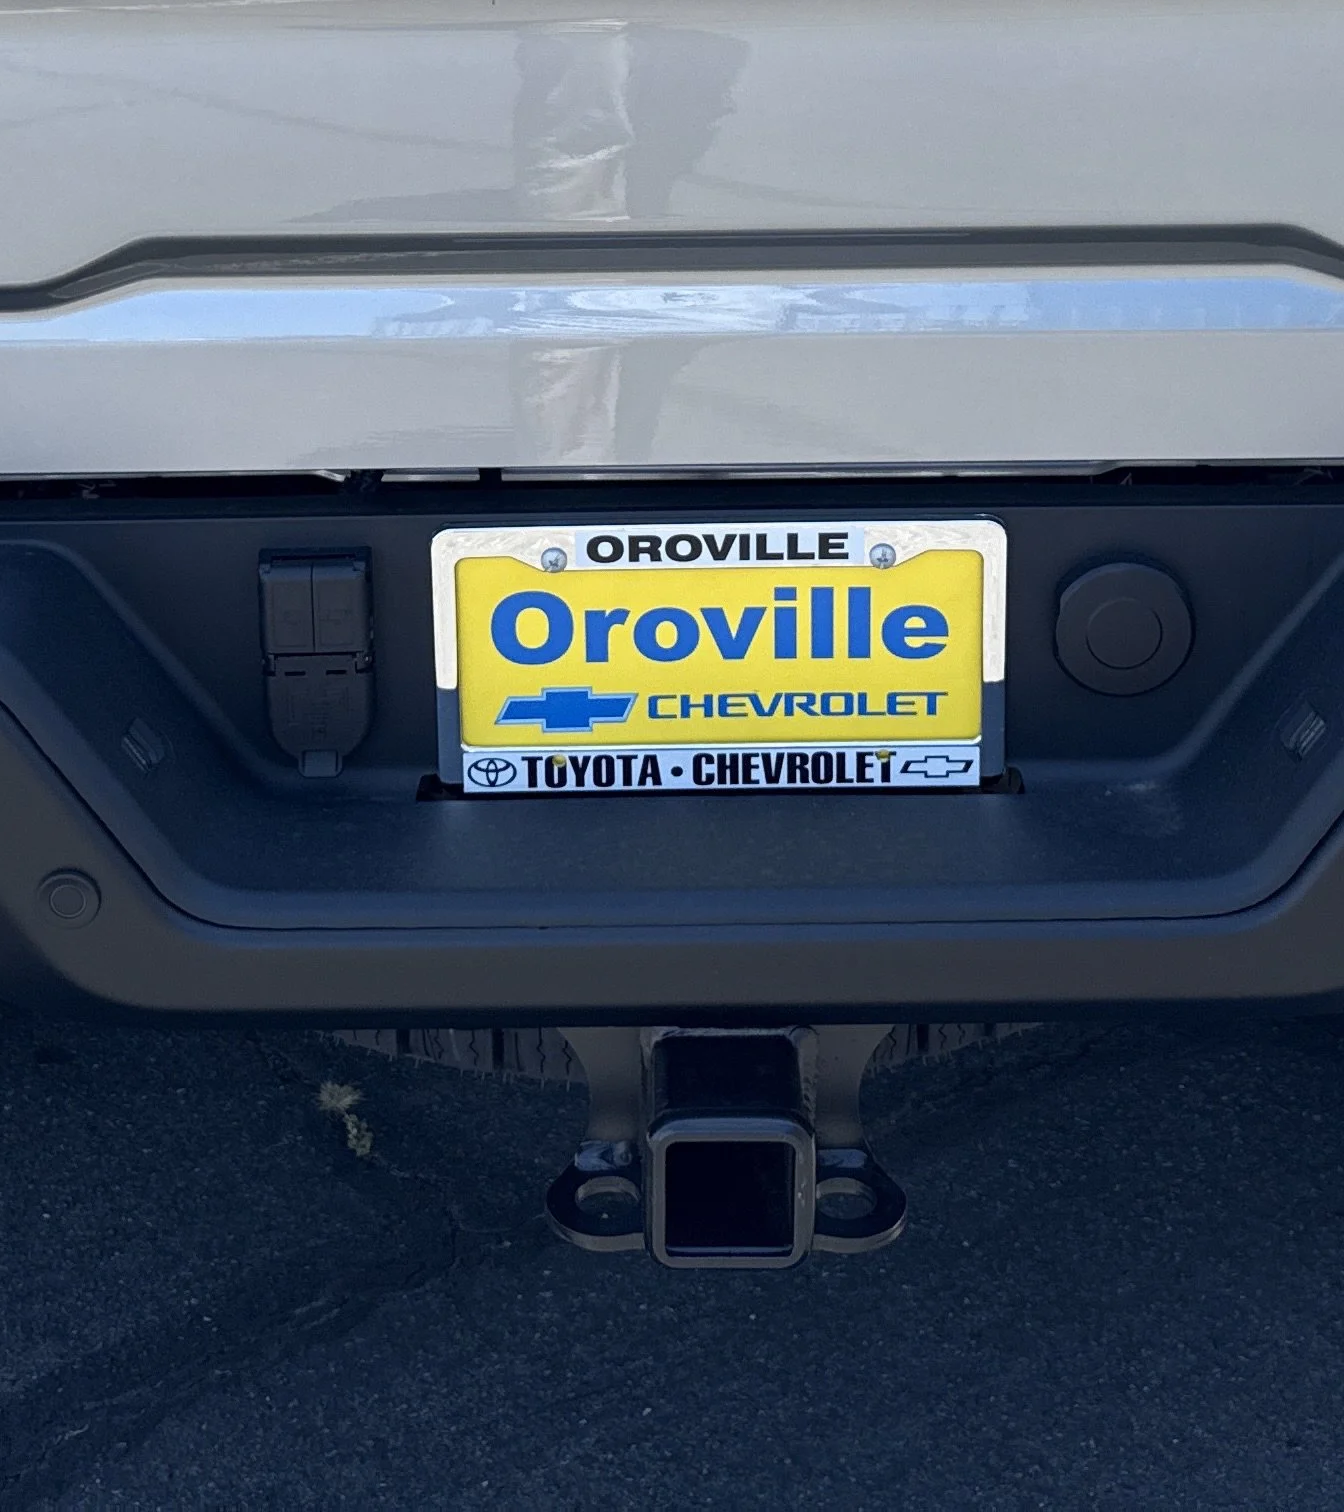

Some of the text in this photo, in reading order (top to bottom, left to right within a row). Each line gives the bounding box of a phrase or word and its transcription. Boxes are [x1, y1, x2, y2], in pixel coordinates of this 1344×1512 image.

[585, 531, 850, 564] OROVILLE
[490, 586, 950, 666] Oroville
[647, 691, 949, 720] CHEVROLET
[521, 750, 898, 789] TOYOTA CHEVROLET
